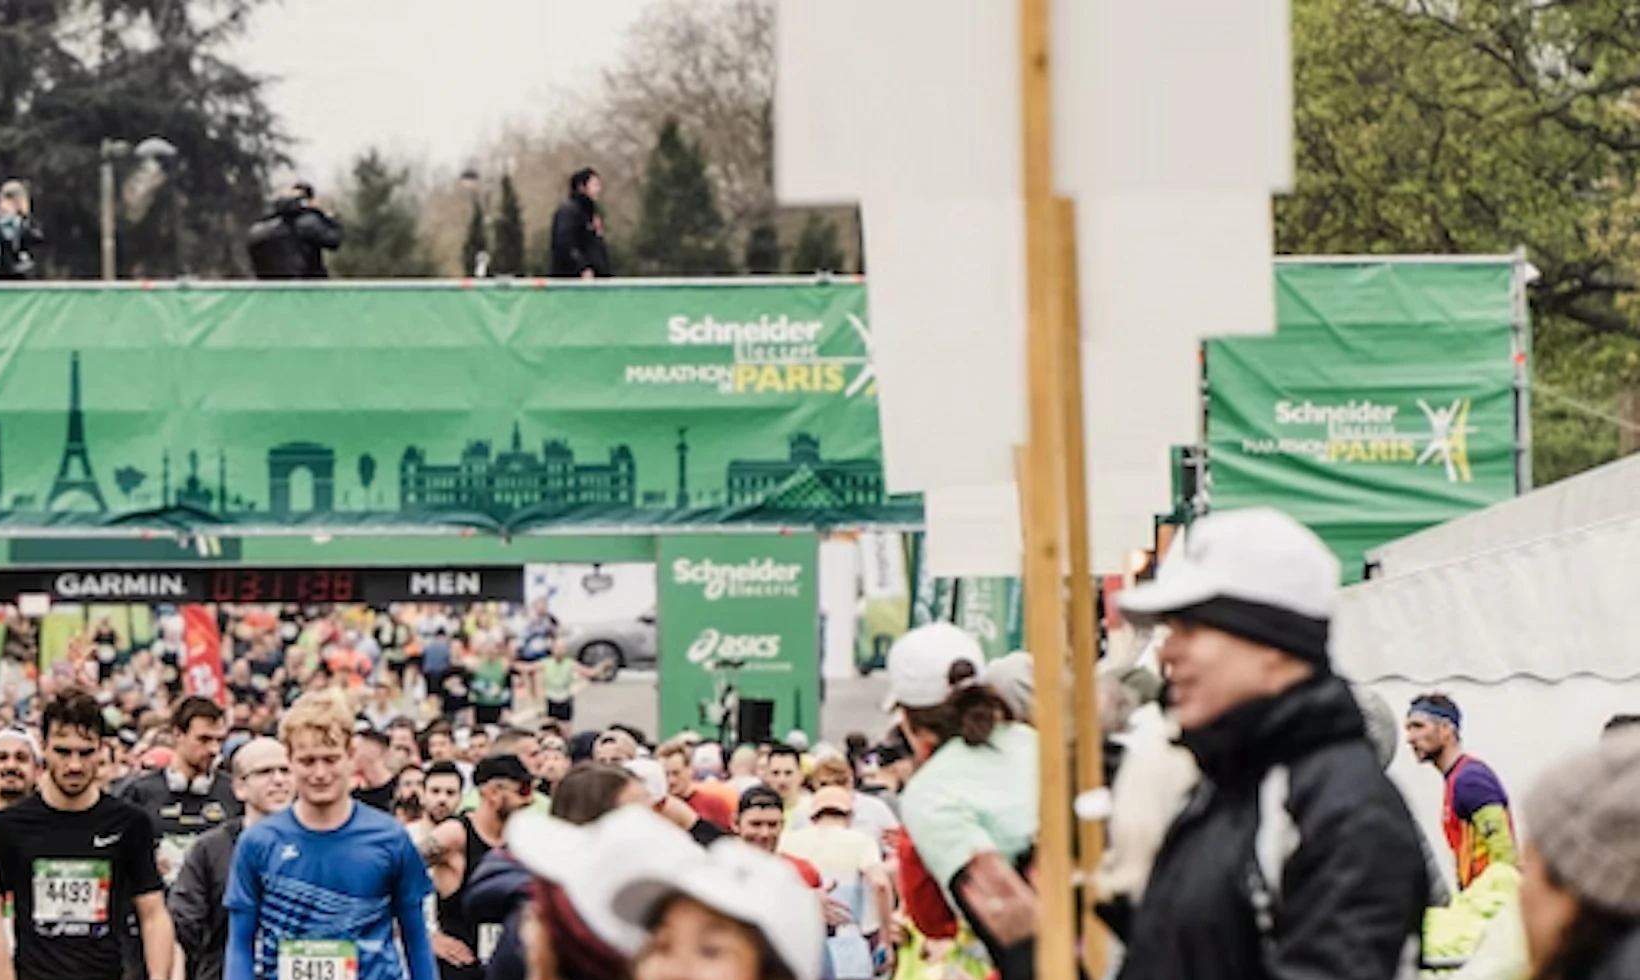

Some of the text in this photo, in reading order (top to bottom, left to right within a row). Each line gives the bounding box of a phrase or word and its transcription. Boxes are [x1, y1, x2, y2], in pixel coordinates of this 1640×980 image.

[667, 315, 823, 344] Schneider
[625, 365, 734, 384] MARATHON
[735, 364, 845, 393] PARIS
[1274, 400, 1398, 424] Schneider
[1327, 440, 1416, 462] PARIS
[56, 571, 183, 596] GARMIN
[410, 571, 481, 596] MEN
[672, 557, 803, 600] Schneider
[717, 634, 782, 658] asics
[46, 881, 91, 903] 4493
